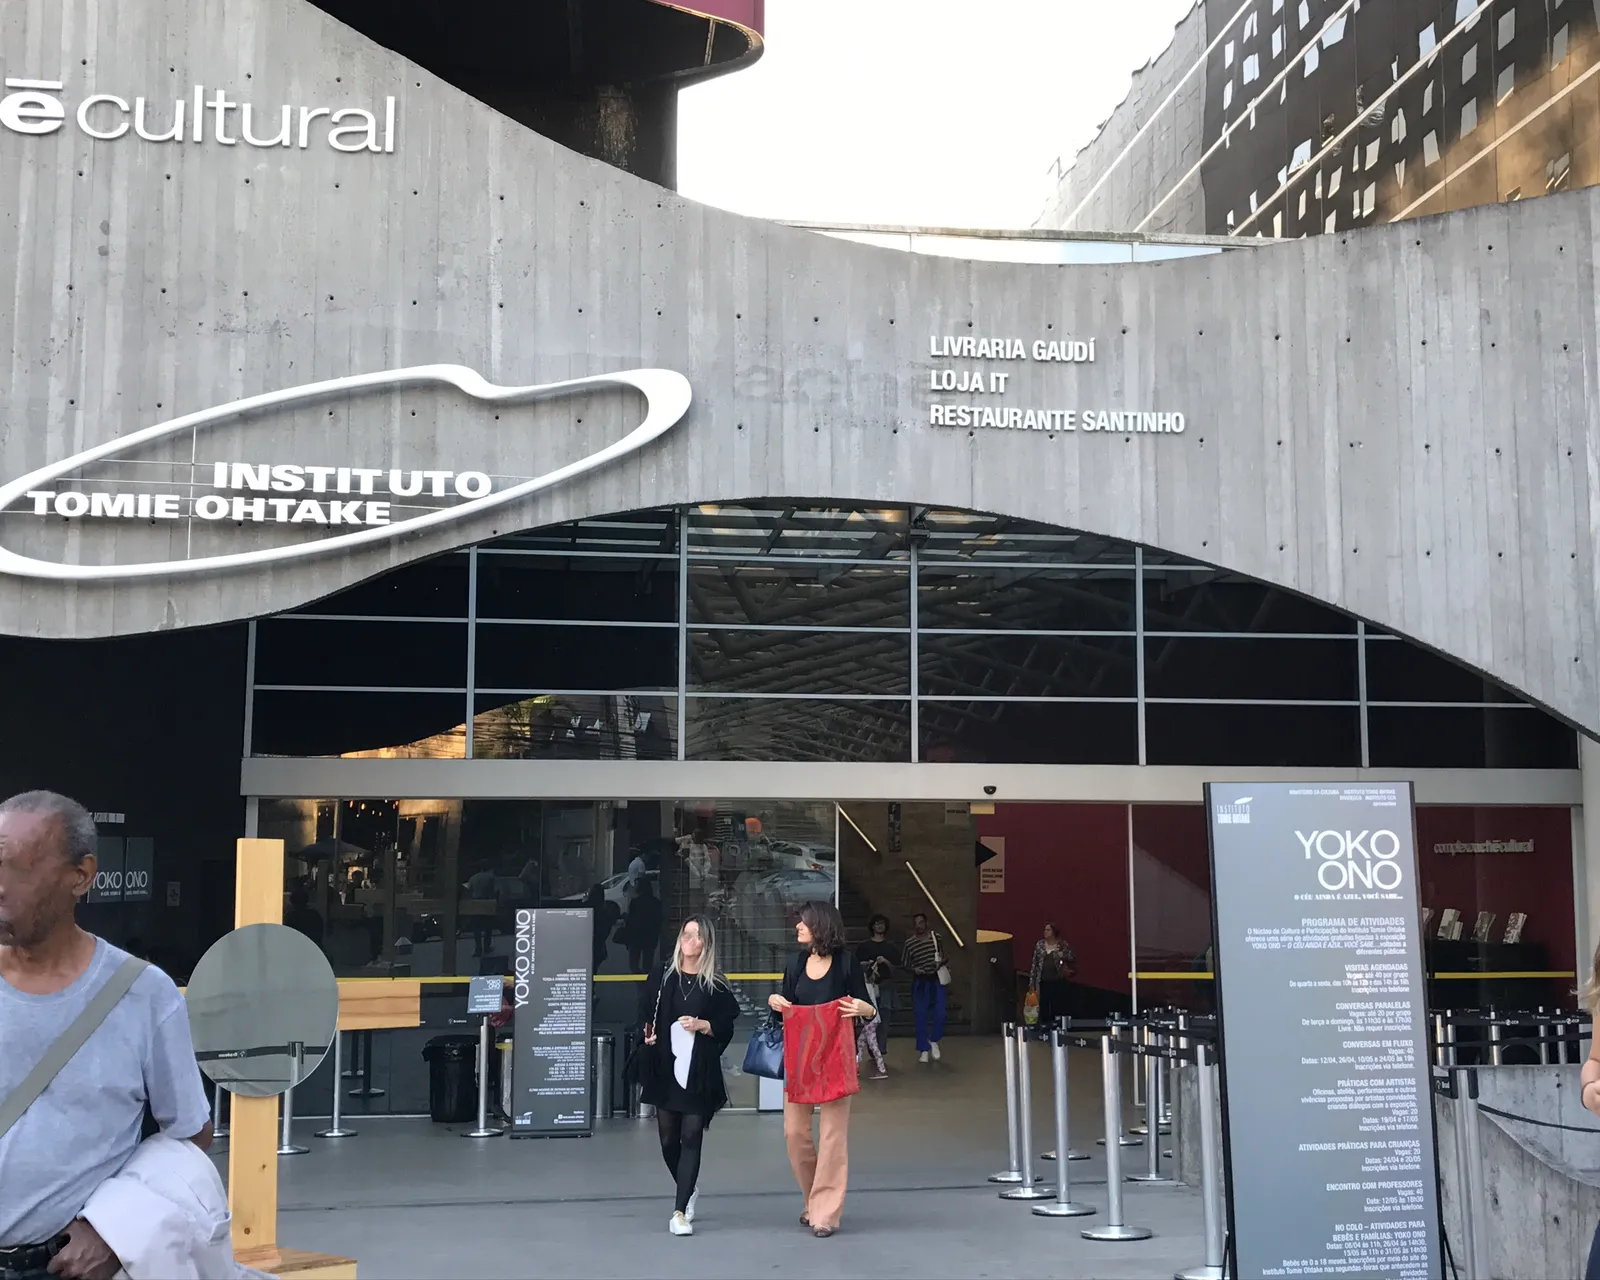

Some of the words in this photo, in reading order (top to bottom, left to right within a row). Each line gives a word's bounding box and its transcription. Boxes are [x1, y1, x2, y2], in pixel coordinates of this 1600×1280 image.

[76, 85, 395, 153] cultural
[930, 336, 1026, 359] LIVRARIA
[1032, 337, 1095, 362] GAUDÍ
[930, 369, 984, 392] LOJA
[990, 372, 1008, 393] IT
[930, 404, 1076, 431] RESTAURANTE
[1082, 411, 1185, 433] SANTINHO
[213, 461, 492, 498] INSTITUTO
[26, 491, 180, 519] TOMIE
[194, 497, 391, 525] OHTAKE
[1294, 830, 1400, 860] YOKO
[126, 870, 148, 888] ONO
[1318, 860, 1402, 890] ONO
[516, 909, 531, 954] ONO
[1301, 918, 1345, 926] PROGRAMA
[1347, 918, 1358, 926] DE
[1360, 917, 1404, 926] ATIVIDADES
[515, 956, 530, 1009] YOKO
[1342, 1040, 1380, 1048] CONVERSAS
[1337, 1078, 1368, 1087] PRÁTICAS
[1385, 1078, 1415, 1086] ARTISTAS
[1298, 1143, 1336, 1151] ATIVIDADES
[1337, 1141, 1368, 1150] PRÁTICAS
[1388, 1141, 1420, 1150] CRIANÇAS
[1326, 1182, 1360, 1191] ENCONTRO
[1377, 1180, 1422, 1189] PROFESSORES
[1332, 1232, 1353, 1242] BEBÊS
[1361, 1231, 1392, 1240] FAMÍLIAS:
[1393, 1231, 1411, 1239] YOKO
[1345, 1223, 1362, 1231] COLO
[1370, 1221, 1407, 1230] ATIVIDADES
[1408, 1221, 1425, 1229] PARA
